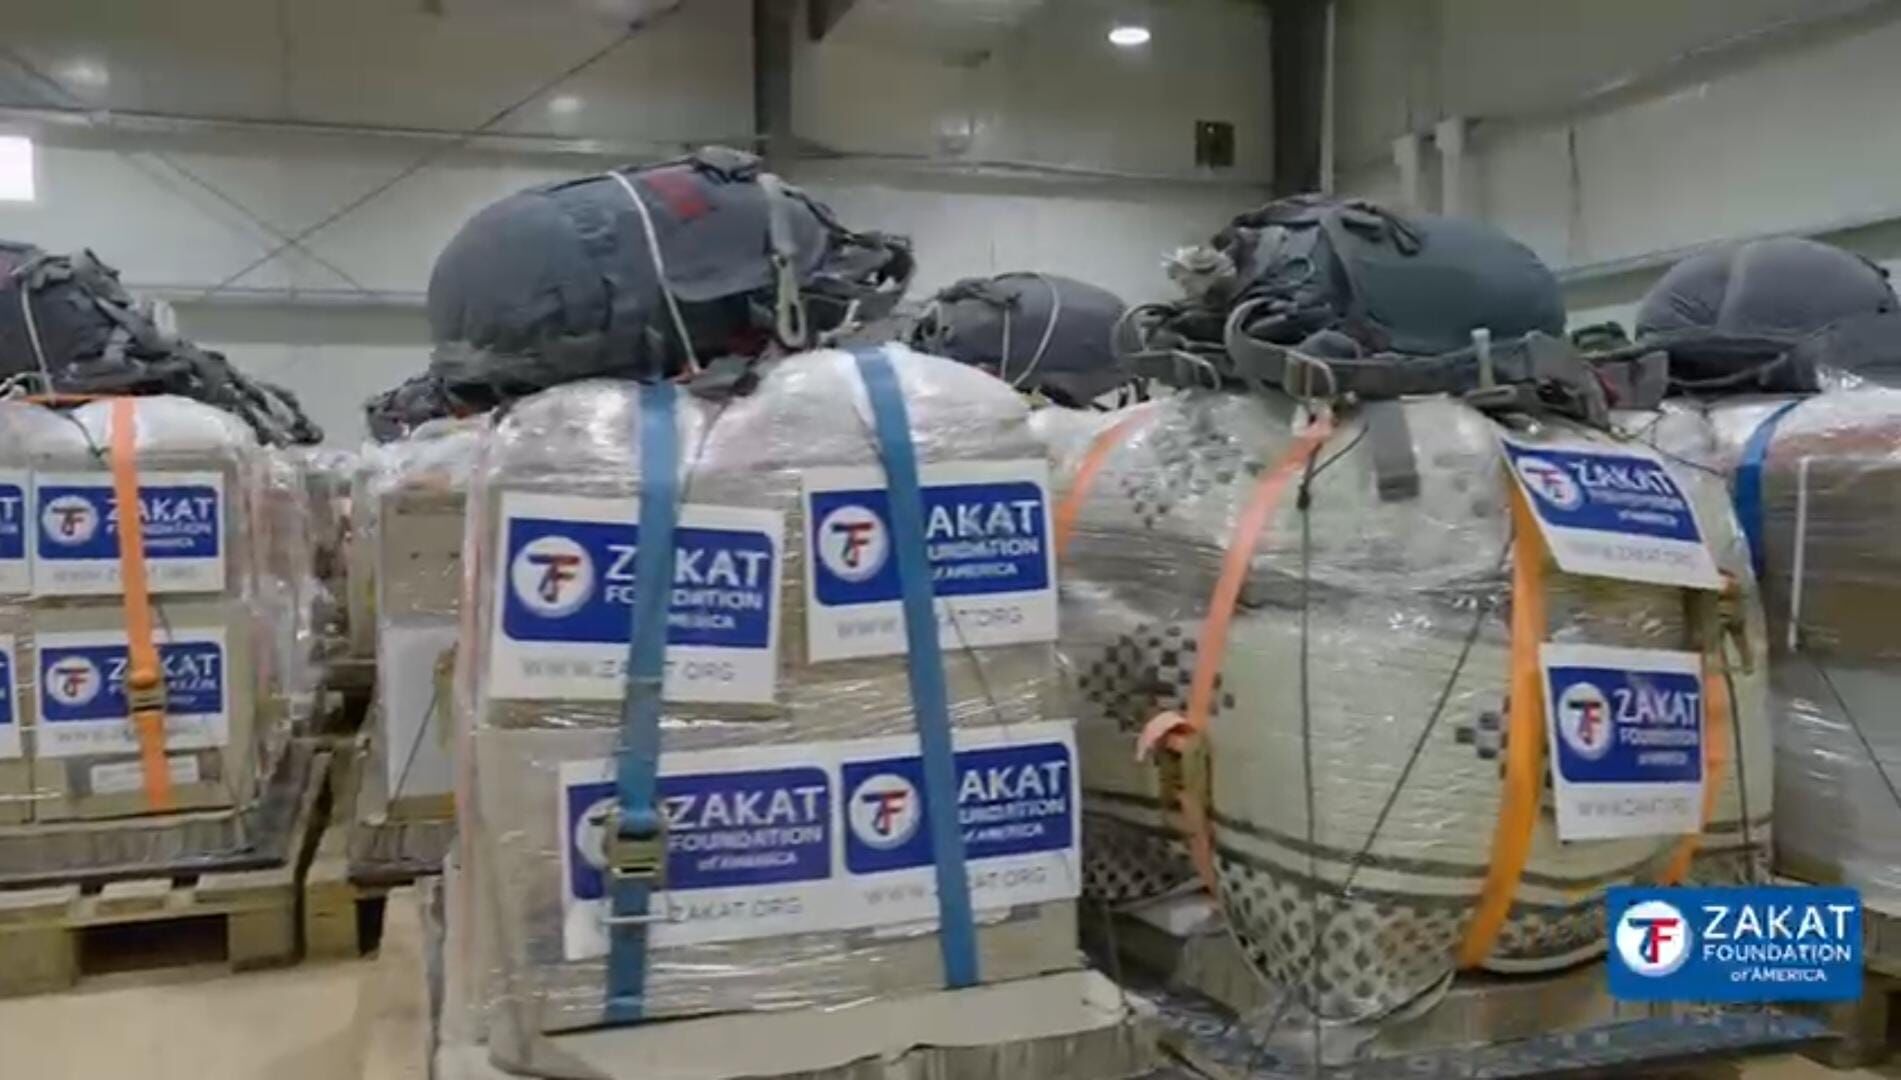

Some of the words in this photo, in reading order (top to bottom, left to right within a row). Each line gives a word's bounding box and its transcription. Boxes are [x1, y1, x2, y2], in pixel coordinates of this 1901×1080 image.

[1568, 460, 1674, 496] ZAKAT
[926, 500, 1040, 538] AKAT
[605, 545, 769, 587] ZKAT
[928, 537, 1040, 560] UNDATION
[606, 586, 764, 610] FODATION
[107, 653, 217, 681] ZKAT
[1613, 688, 1699, 726] ZAKAT
[959, 760, 1067, 802] AKAT
[664, 786, 826, 830] ZAKAT
[959, 797, 1066, 823] UNDATION
[669, 827, 824, 851] FOUNDATION
